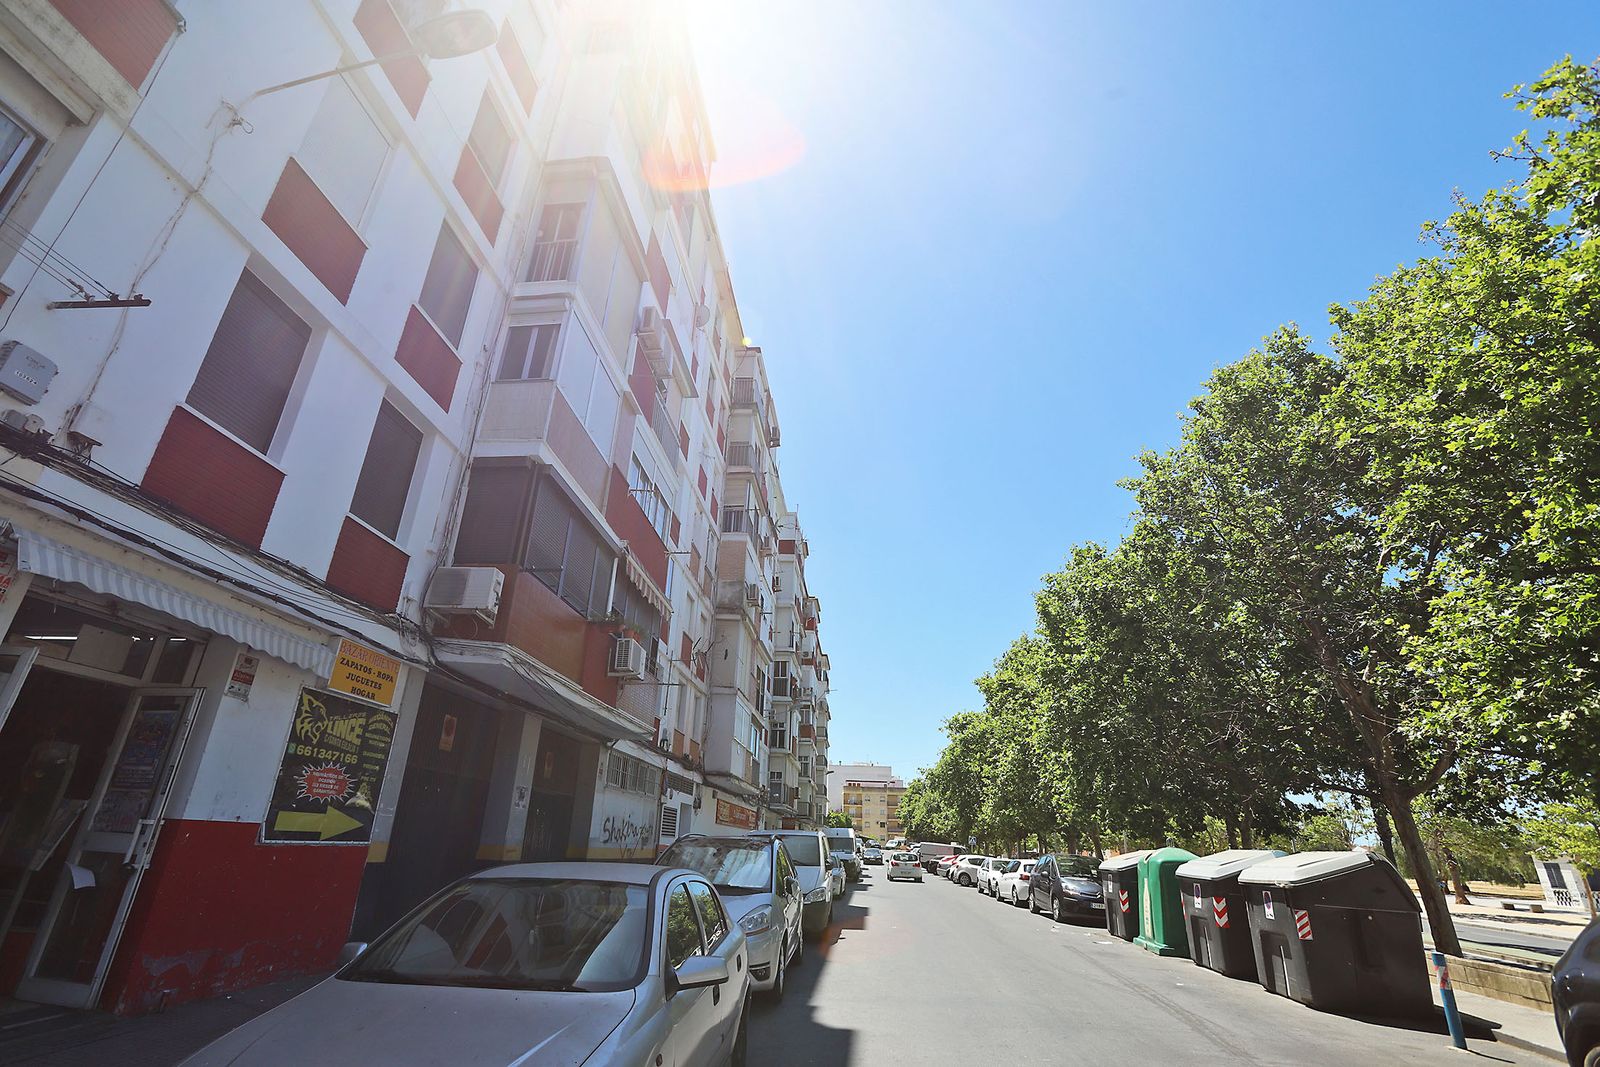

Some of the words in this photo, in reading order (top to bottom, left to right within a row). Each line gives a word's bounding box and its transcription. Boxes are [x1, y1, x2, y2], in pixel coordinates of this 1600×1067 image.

[340, 640, 368, 662] BAZAR
[340, 657, 373, 675] ZAPATOS
[376, 670, 394, 683] ROPA
[345, 672, 383, 690] JUGUETES
[350, 686, 376, 700] HOGAR
[326, 718, 367, 746] LINCE
[296, 744, 359, 764] 661347166
